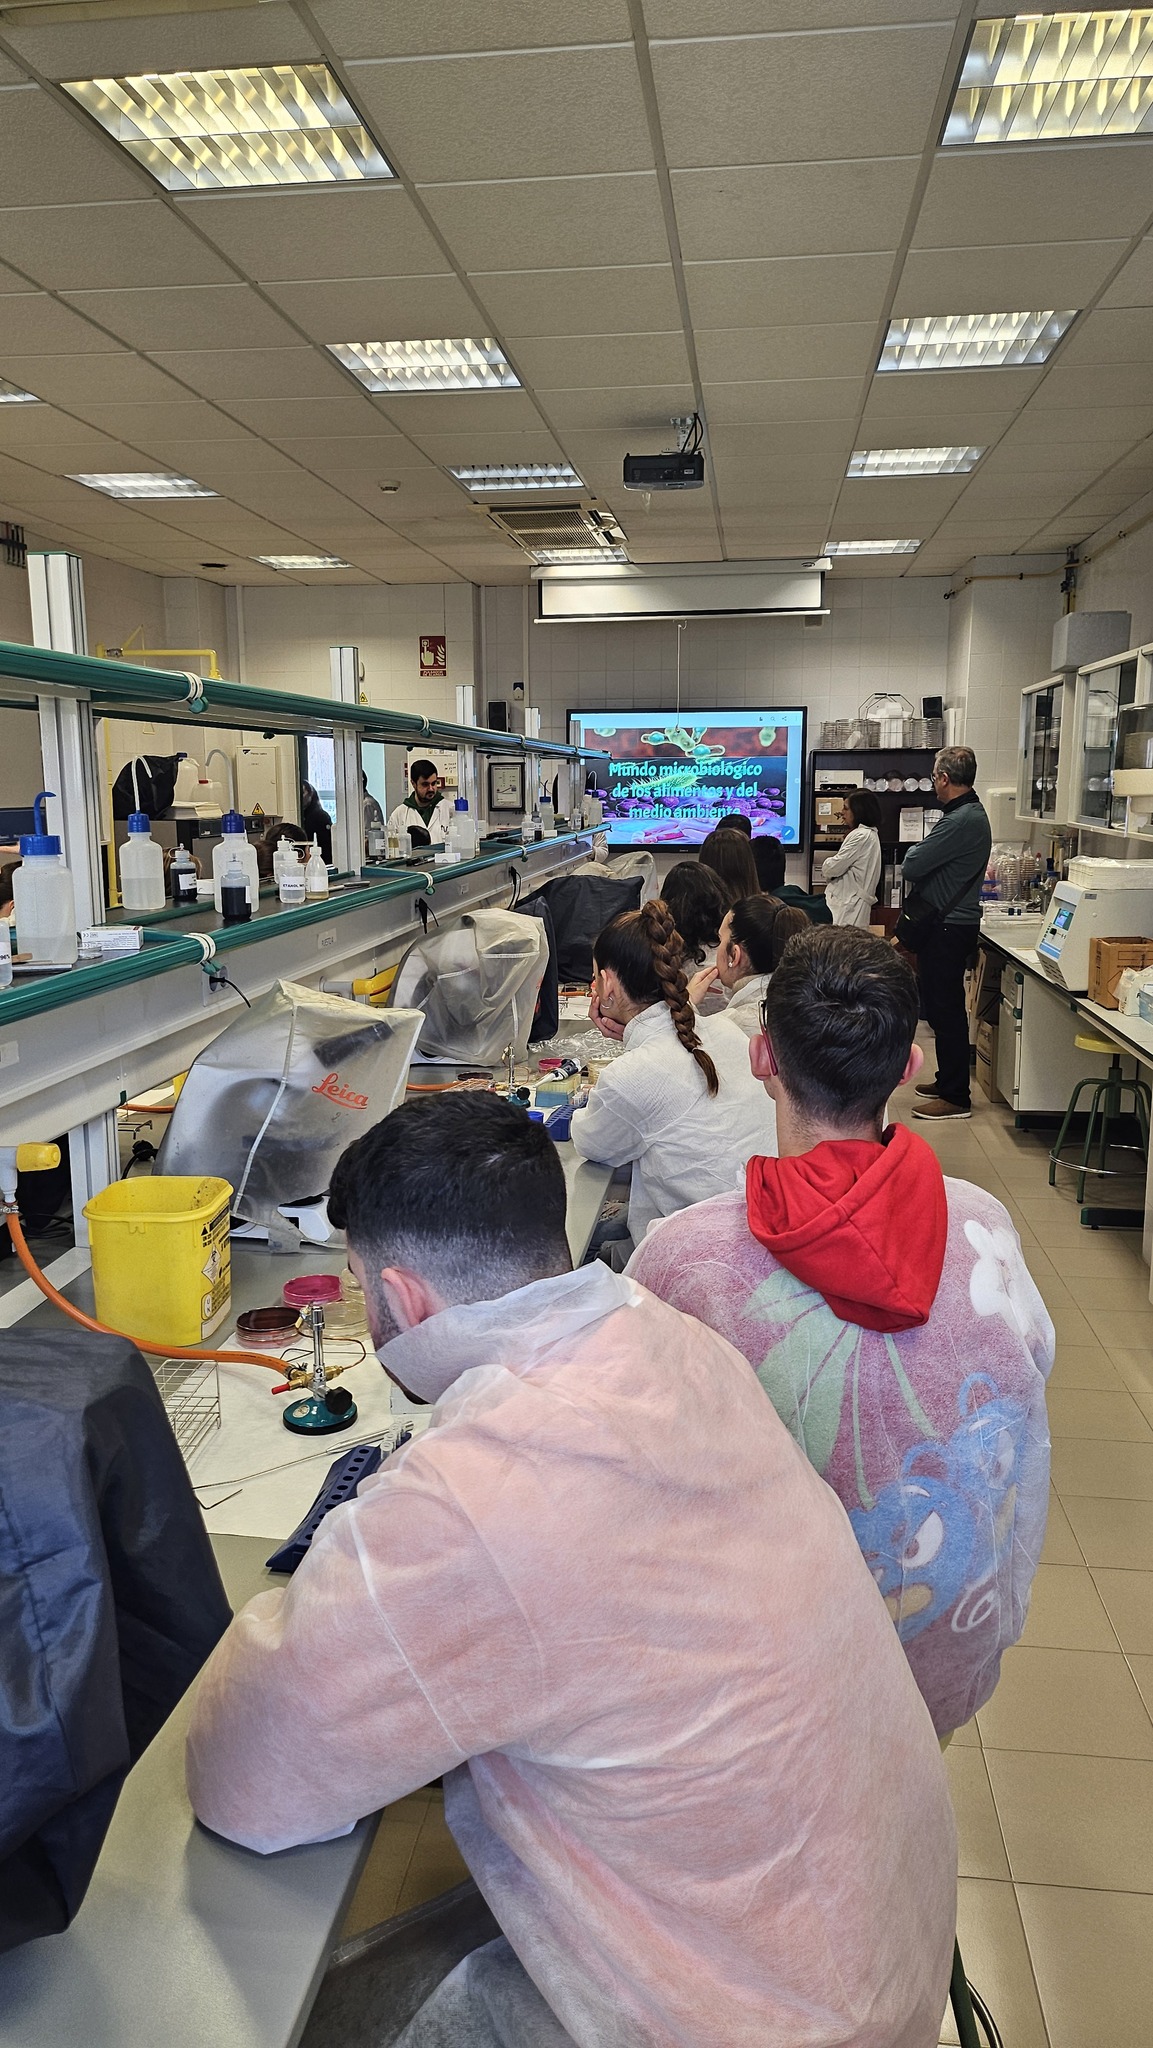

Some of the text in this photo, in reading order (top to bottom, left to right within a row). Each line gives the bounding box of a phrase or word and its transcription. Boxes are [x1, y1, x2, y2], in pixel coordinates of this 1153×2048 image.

[609, 760, 763, 780] Mundo microbiológico
[612, 781, 758, 800] de los alimentos y del
[629, 803, 741, 818] medio ambiente
[311, 1072, 369, 1110] Leica
